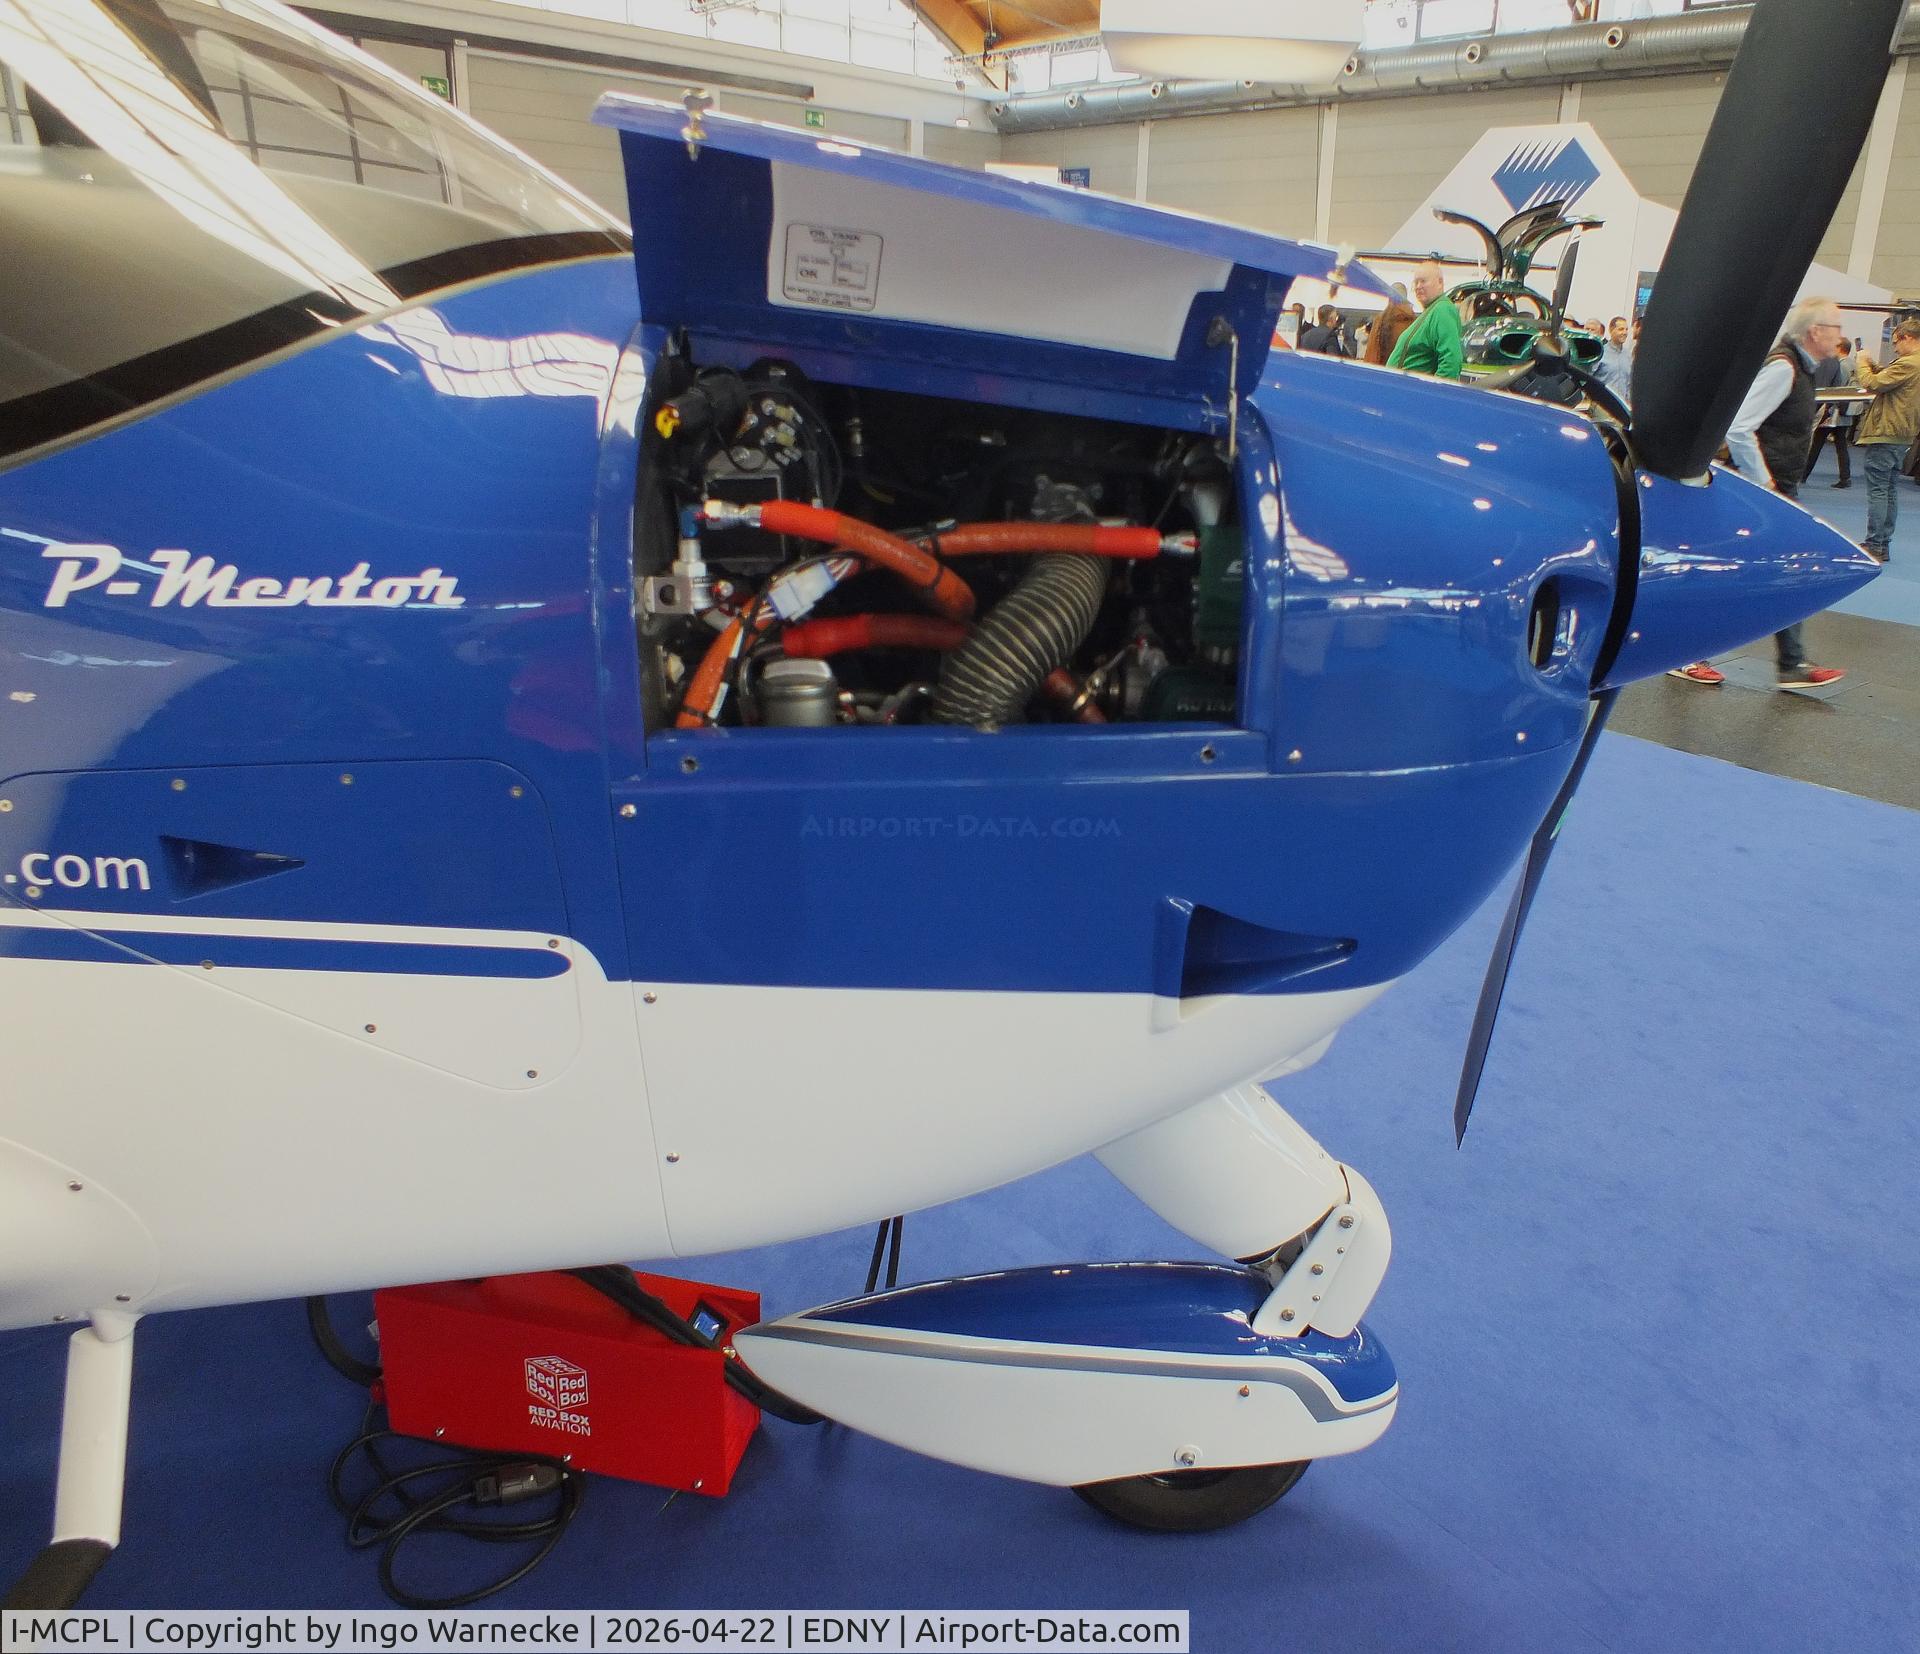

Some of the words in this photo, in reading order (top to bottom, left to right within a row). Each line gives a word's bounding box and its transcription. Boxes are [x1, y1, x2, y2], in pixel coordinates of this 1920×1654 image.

[42, 544, 466, 608] P-Mentor
[4, 852, 151, 890] .com
[527, 1364, 555, 1389] Red
[559, 1376, 585, 1391] Red
[528, 1378, 556, 1404] Box
[560, 1392, 586, 1406] Box
[528, 1405, 557, 1419] RED
[560, 1411, 590, 1426] BOX
[530, 1415, 591, 1437] AVIATION
